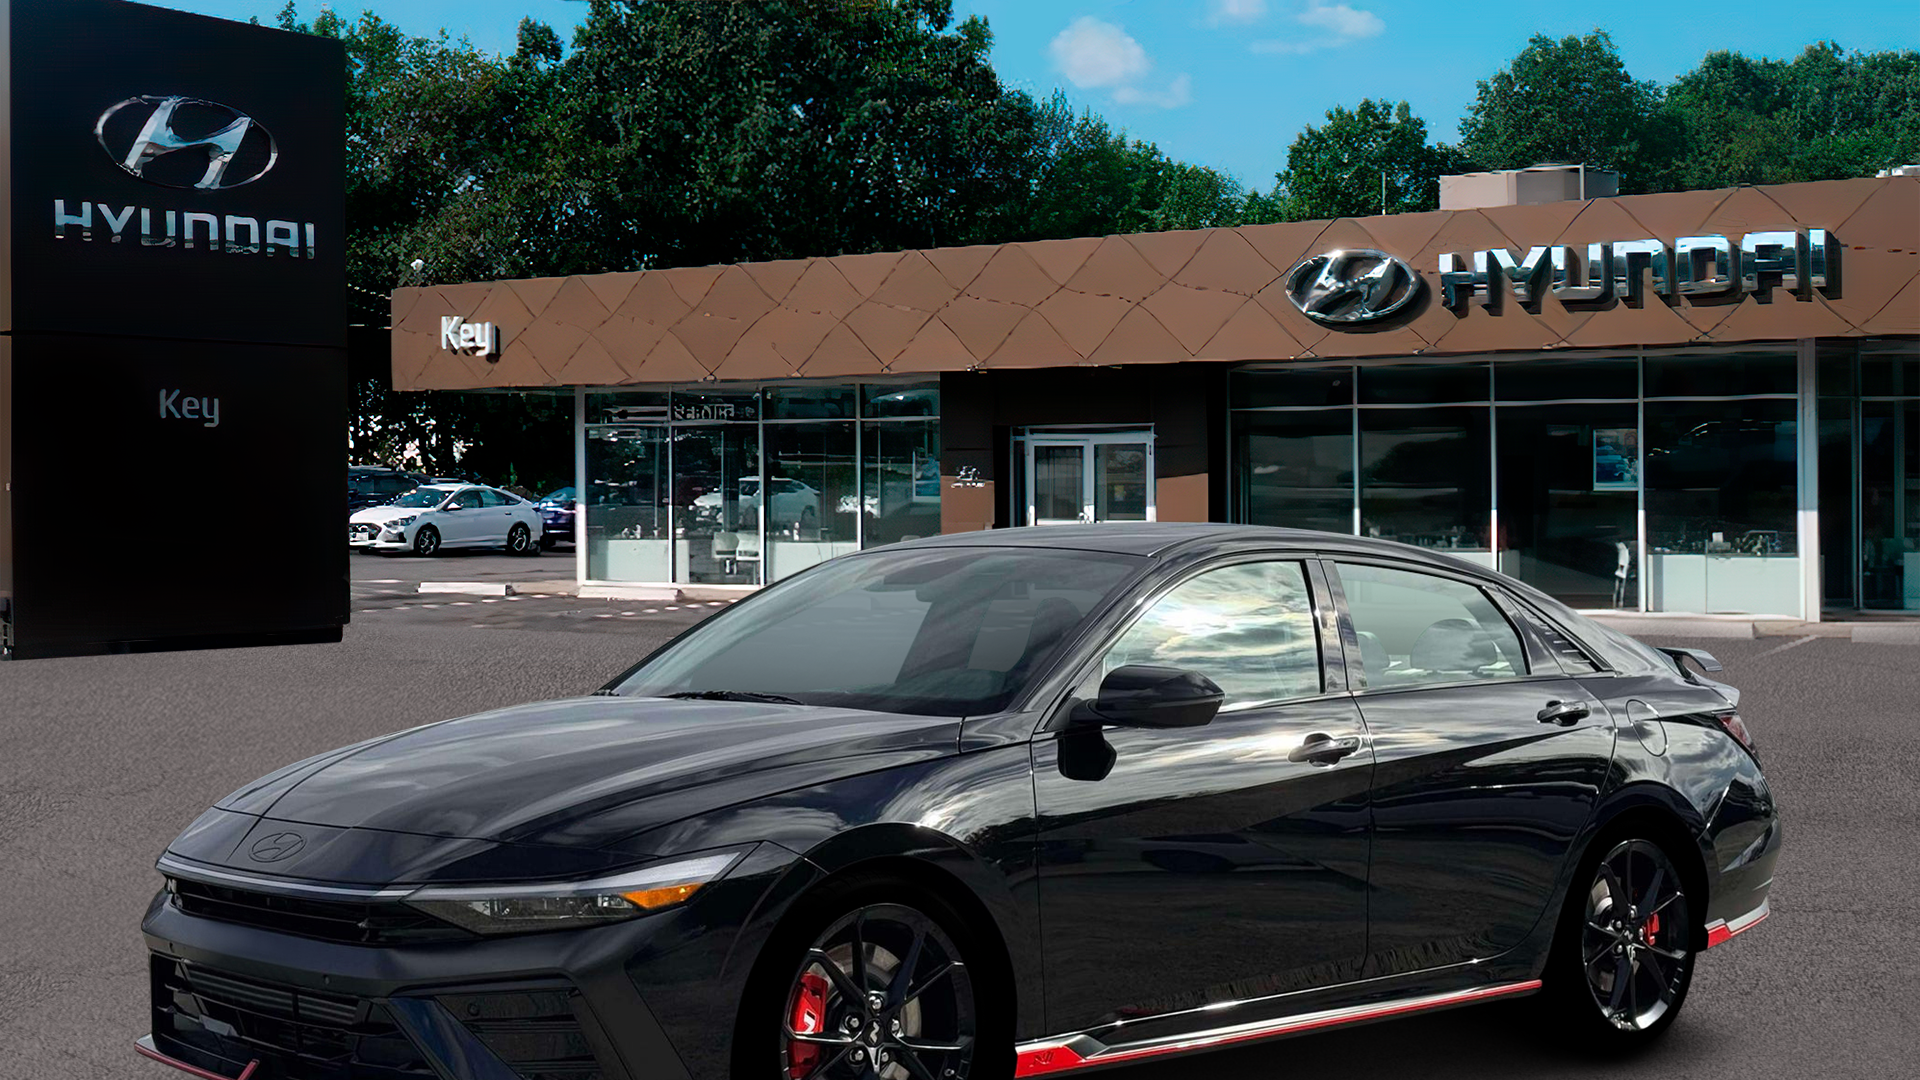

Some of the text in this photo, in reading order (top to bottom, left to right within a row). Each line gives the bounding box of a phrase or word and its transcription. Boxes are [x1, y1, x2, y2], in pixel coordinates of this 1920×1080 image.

[54, 198, 315, 260] HYUNDAI
[1438, 228, 1836, 314] HYUNDAI
[440, 315, 493, 357] Key
[159, 388, 220, 428] Key
